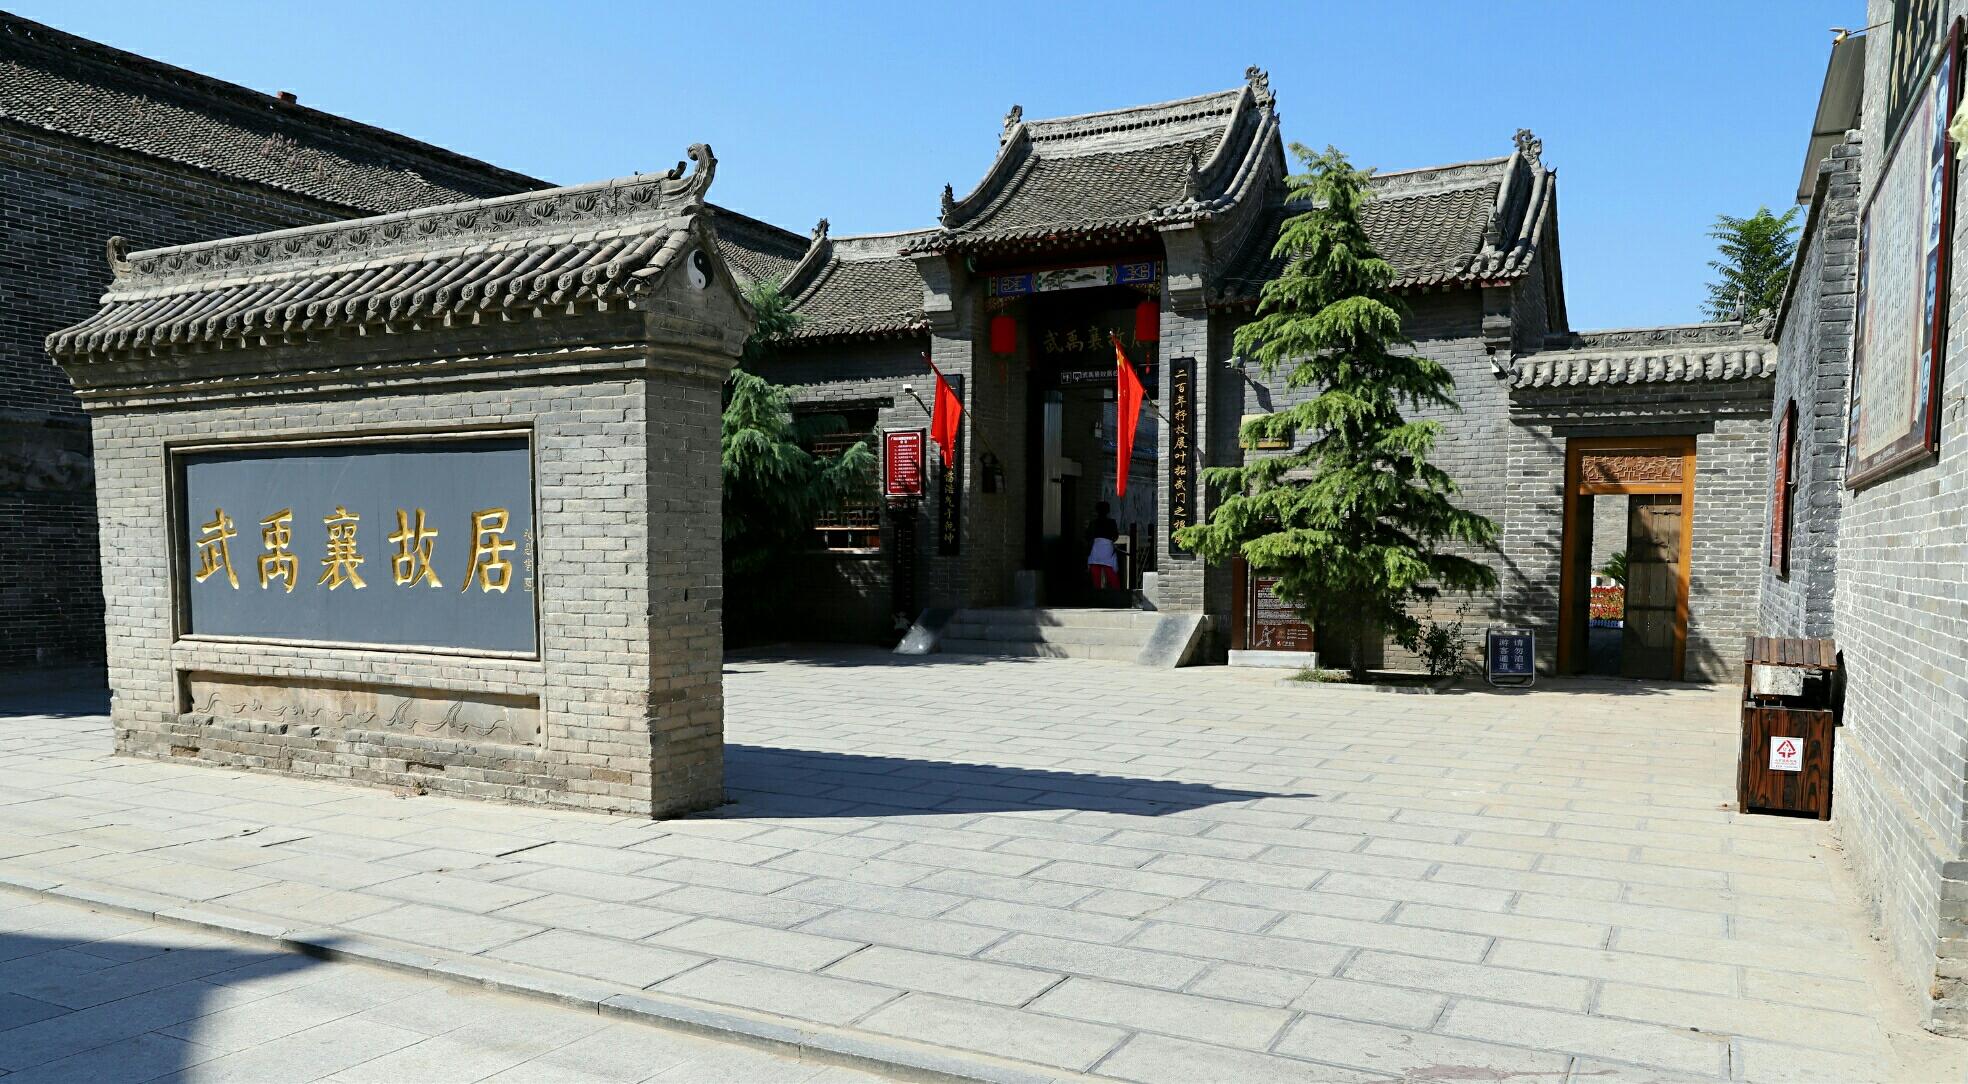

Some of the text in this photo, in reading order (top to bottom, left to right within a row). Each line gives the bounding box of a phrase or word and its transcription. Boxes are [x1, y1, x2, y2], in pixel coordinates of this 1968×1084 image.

[195, 504, 516, 594] 武禹襄故居
